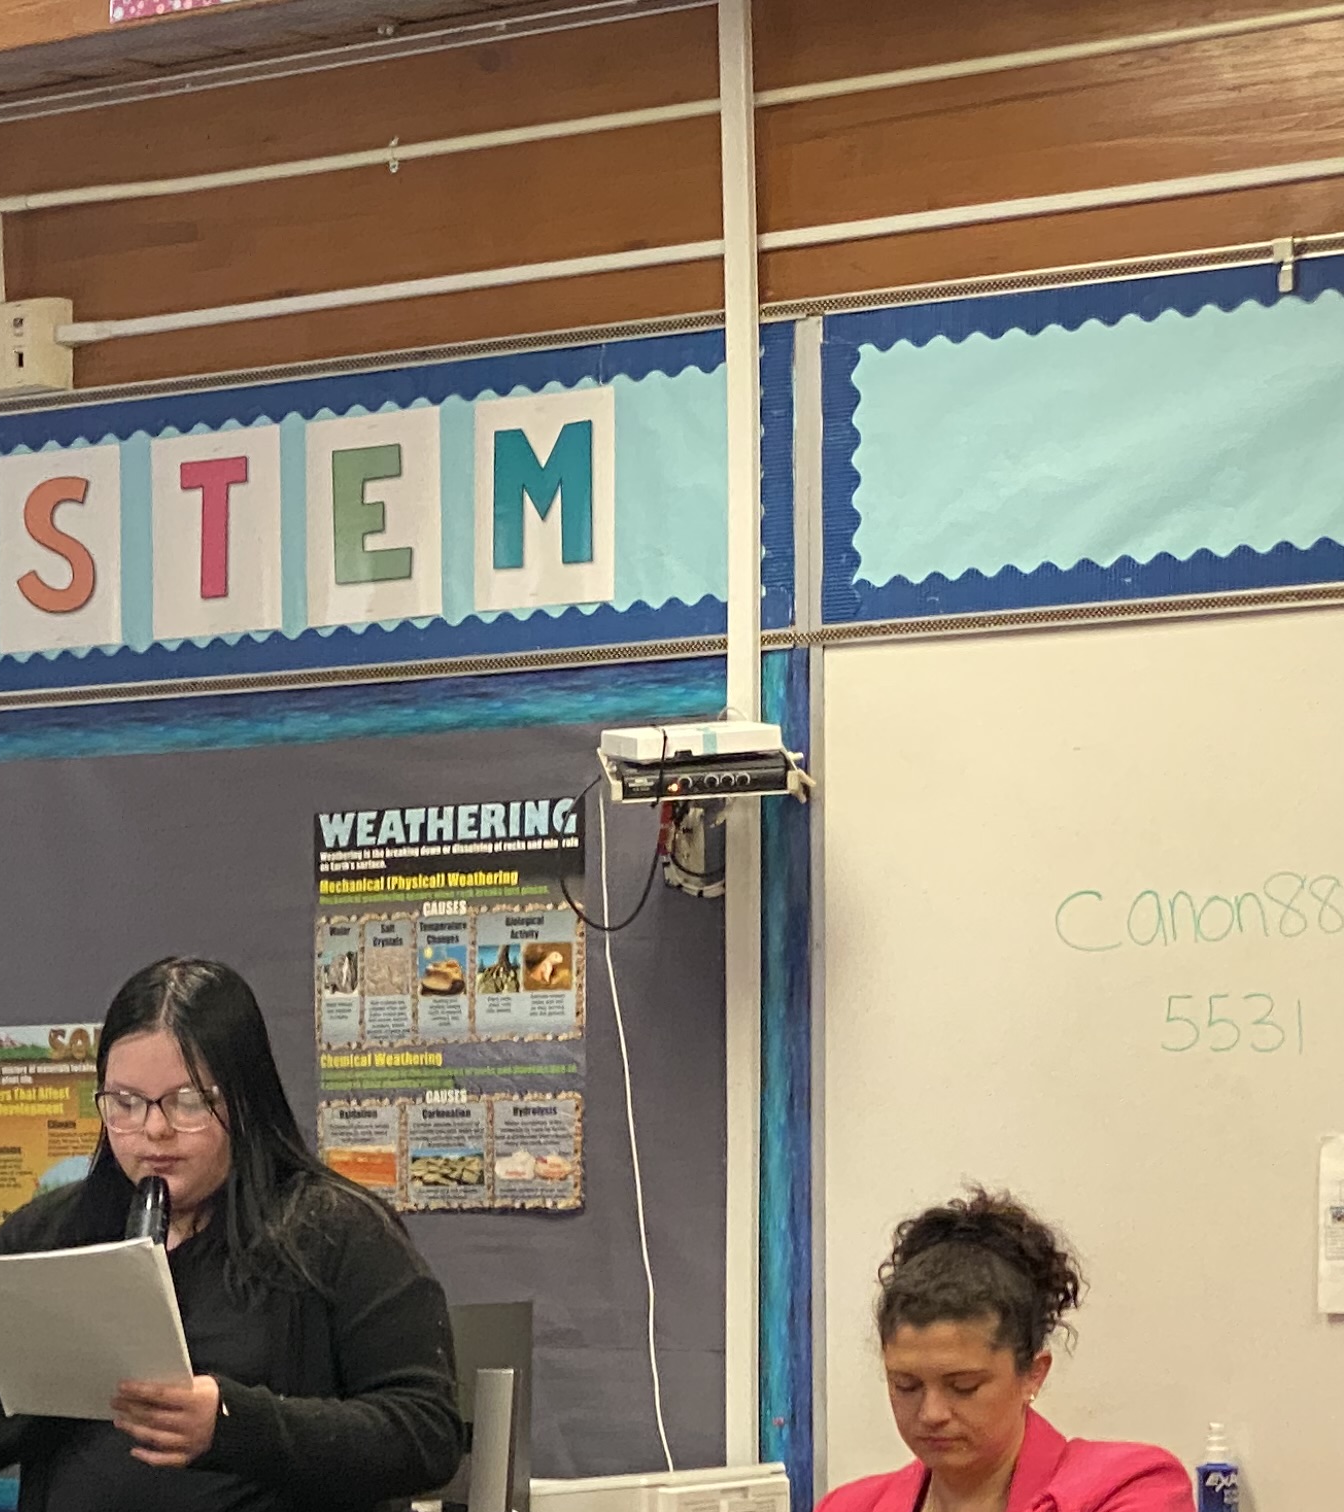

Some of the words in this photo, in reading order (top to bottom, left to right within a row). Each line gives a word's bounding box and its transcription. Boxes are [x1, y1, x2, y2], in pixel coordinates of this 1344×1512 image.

[15, 420, 595, 616] STEM
[318, 797, 577, 848] WEATHERING
[320, 877, 384, 894] Mechanical
[387, 872, 445, 890] (Physical)
[447, 870, 518, 887] Weathering
[422, 900, 467, 918] CAUSES
[510, 928, 540, 940] Activity
[1161, 993, 1303, 1055] 5531
[320, 1053, 372, 1068] Chemical
[374, 1051, 443, 1067] Weathering
[13, 1088, 36, 1100] That
[37, 1086, 70, 1099] Affect
[425, 1089, 468, 1104] CAUSES
